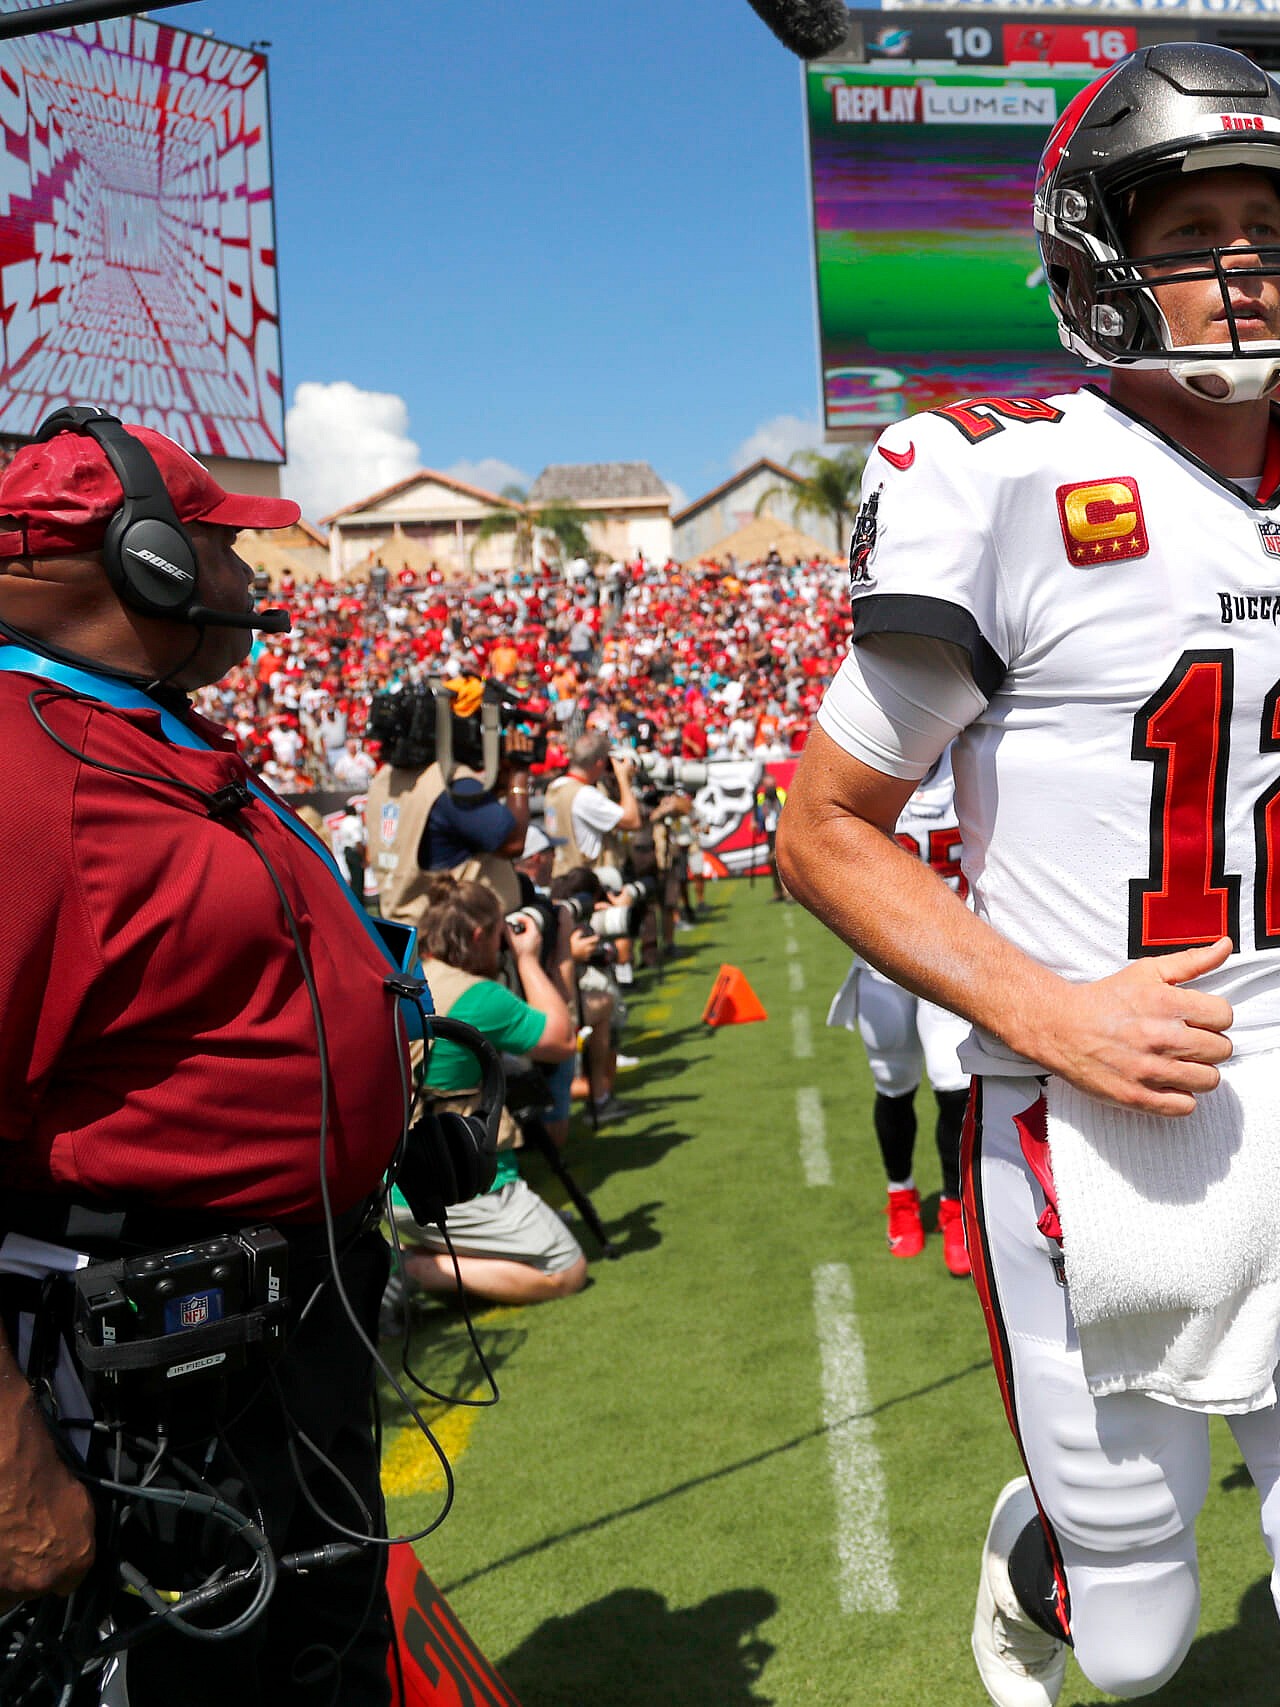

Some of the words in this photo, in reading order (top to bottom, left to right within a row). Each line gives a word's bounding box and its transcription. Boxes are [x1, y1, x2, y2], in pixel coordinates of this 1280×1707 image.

[945, 27, 992, 58] 10
[1082, 31, 1128, 59] 16
[835, 86, 917, 123] REPLAY
[929, 96, 1046, 115] LUMEN
[1064, 484, 1138, 543] C
[126, 547, 194, 581] BOSE
[894, 826, 969, 902] 5
[184, 1308, 208, 1324] NFL
